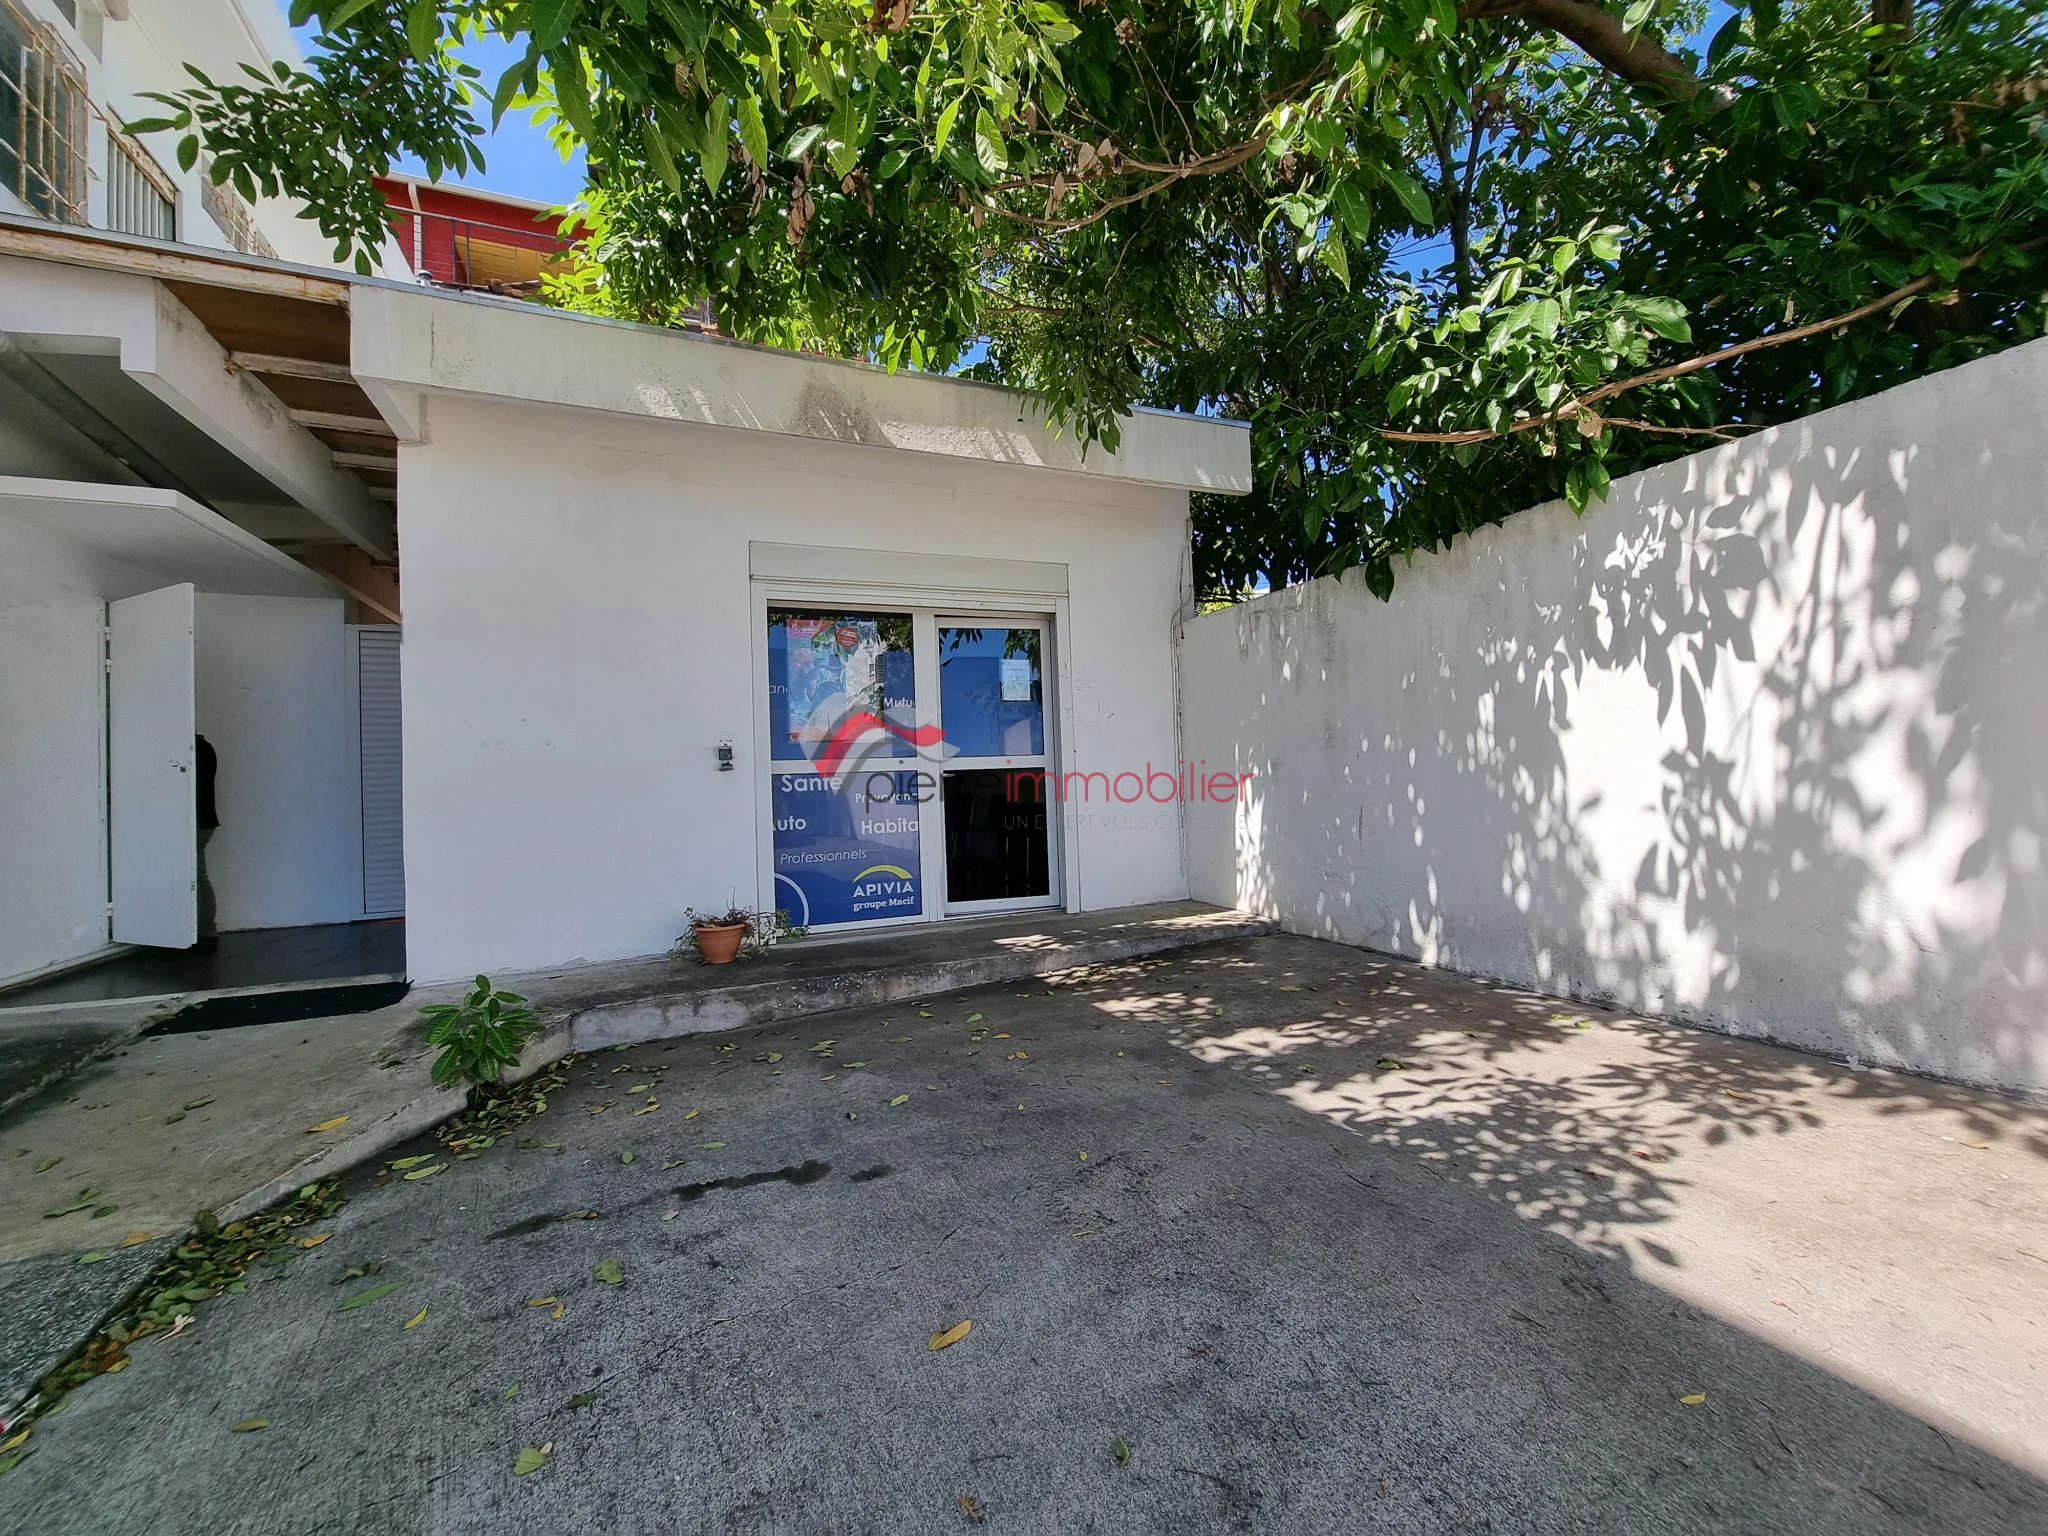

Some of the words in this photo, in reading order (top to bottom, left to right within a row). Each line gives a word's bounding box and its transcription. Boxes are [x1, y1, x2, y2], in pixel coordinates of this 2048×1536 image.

[884, 696, 915, 708] Mutu
[773, 815, 807, 831] uto
[780, 849, 867, 864] Professionnels
[852, 880, 914, 898] APIVIA
[853, 899, 887, 912] groupe
[888, 896, 915, 907] Macif
